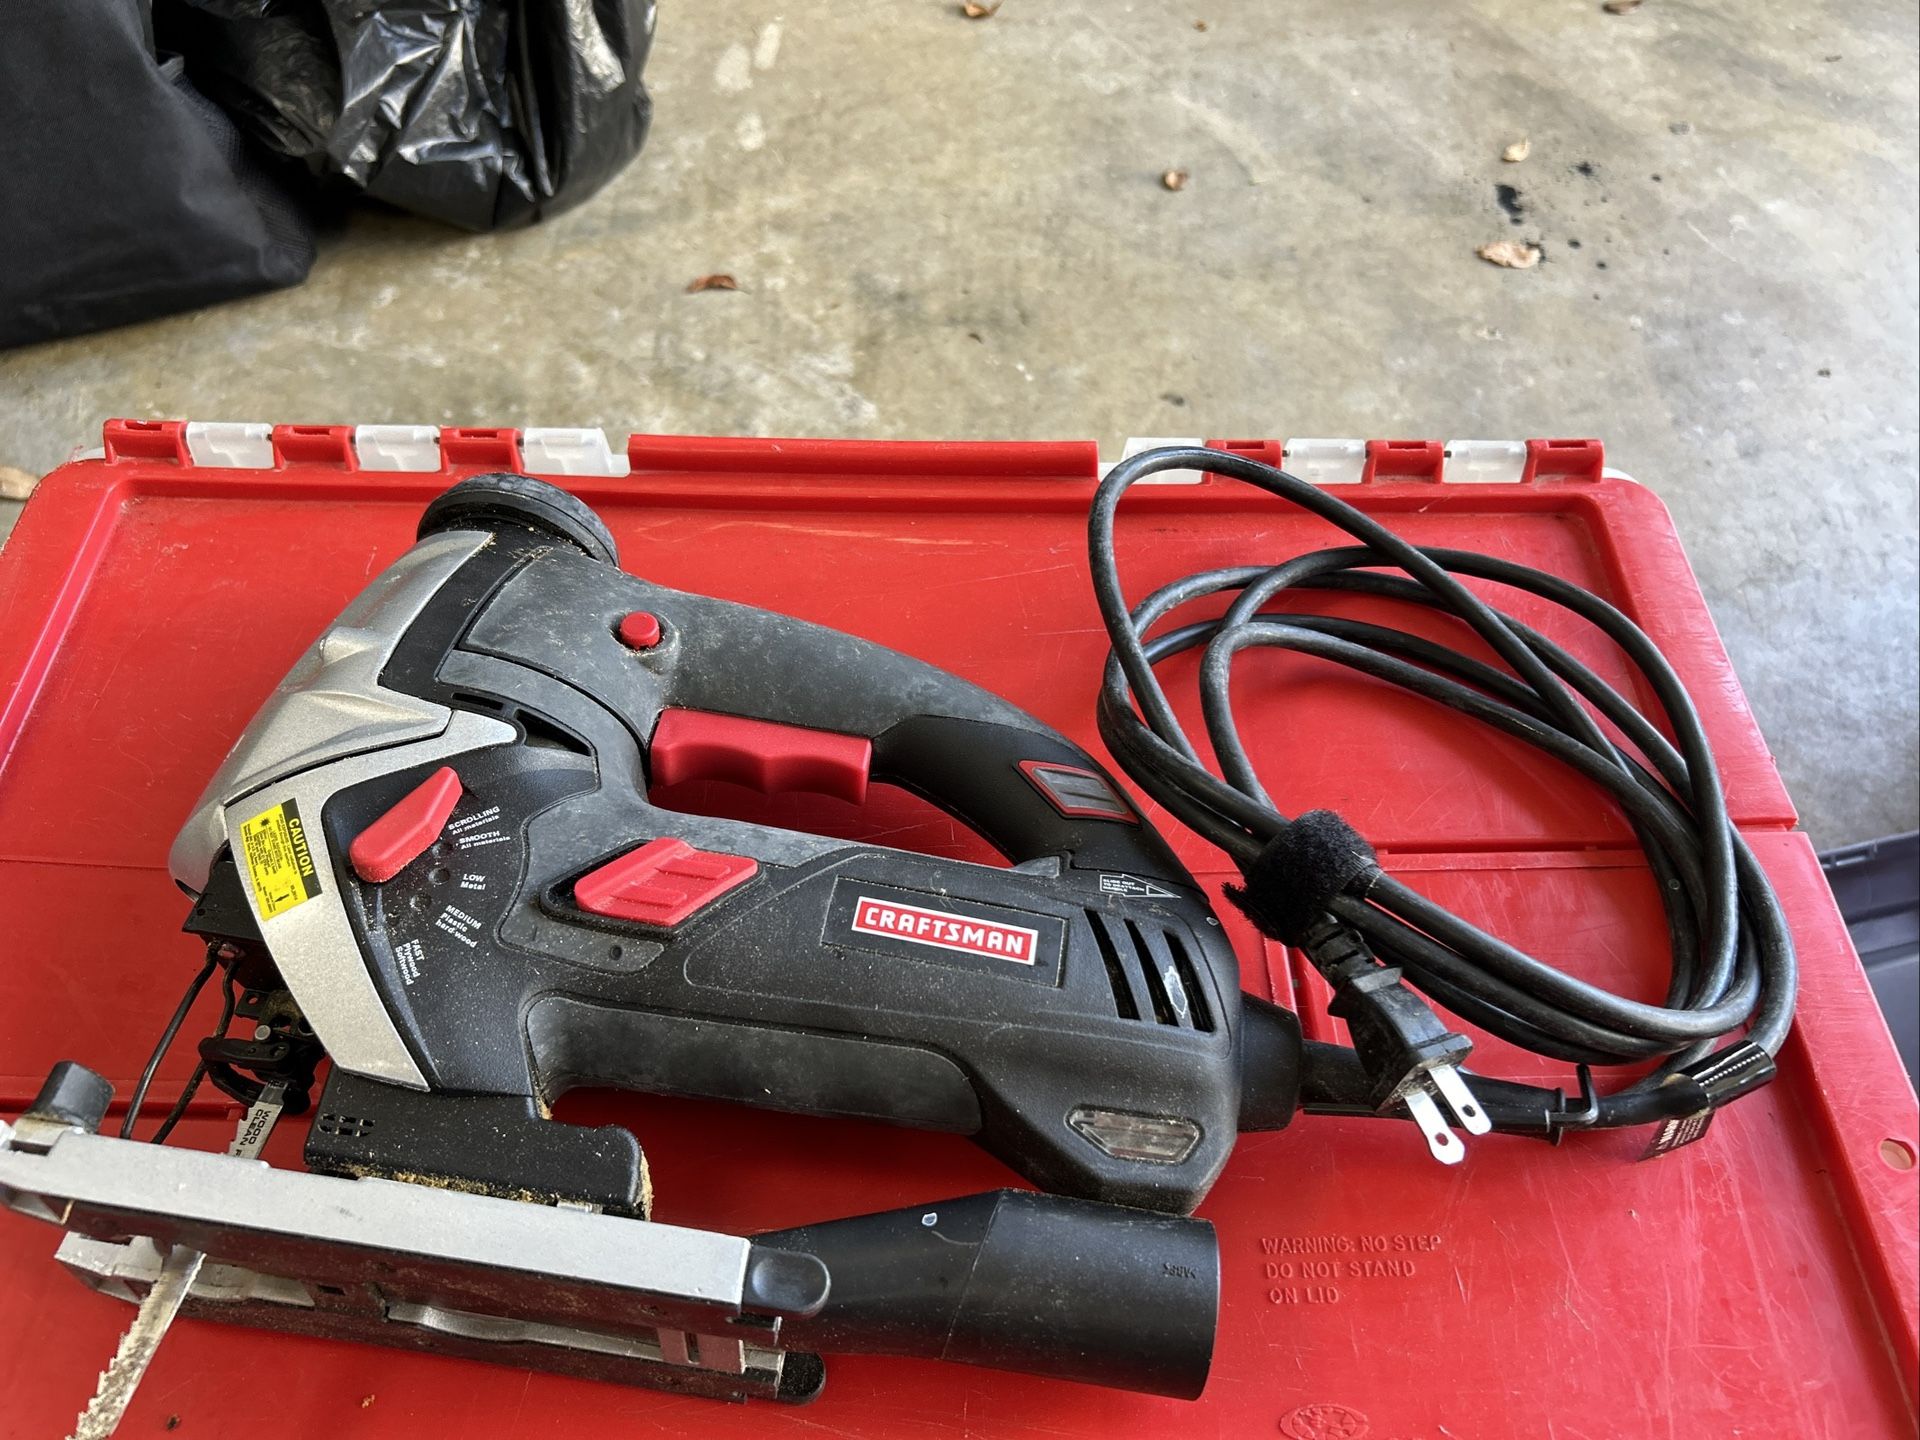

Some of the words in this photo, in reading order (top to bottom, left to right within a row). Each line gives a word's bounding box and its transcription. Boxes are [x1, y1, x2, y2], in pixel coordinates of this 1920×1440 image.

[448, 806, 501, 830] SCROLLING
[452, 827, 463, 835] All
[464, 815, 500, 831] materials
[288, 818, 315, 877] CAUTION
[459, 830, 501, 844] SMOOTH
[473, 836, 511, 847] materials
[460, 881, 486, 891] Metal
[462, 873, 486, 882] LOW
[440, 912, 468, 933] Plastic
[445, 904, 482, 930] MEDIUM
[864, 907, 1023, 955] CRAFTSMAN
[411, 938, 425, 960] FAST
[395, 945, 415, 986] Softwood
[402, 942, 421, 978] Plywood
[239, 1109, 263, 1146] CLEAN
[248, 1110, 272, 1145] WOOD
[1262, 1235, 1355, 1254] WARNING:
[1360, 1234, 1388, 1252] NO
[1393, 1233, 1442, 1251] STEP
[1266, 1262, 1294, 1279] DO
[1302, 1260, 1341, 1279] NOT
[1350, 1259, 1416, 1278] STAND
[1269, 1286, 1299, 1304] ON
[1306, 1286, 1340, 1304] LID
